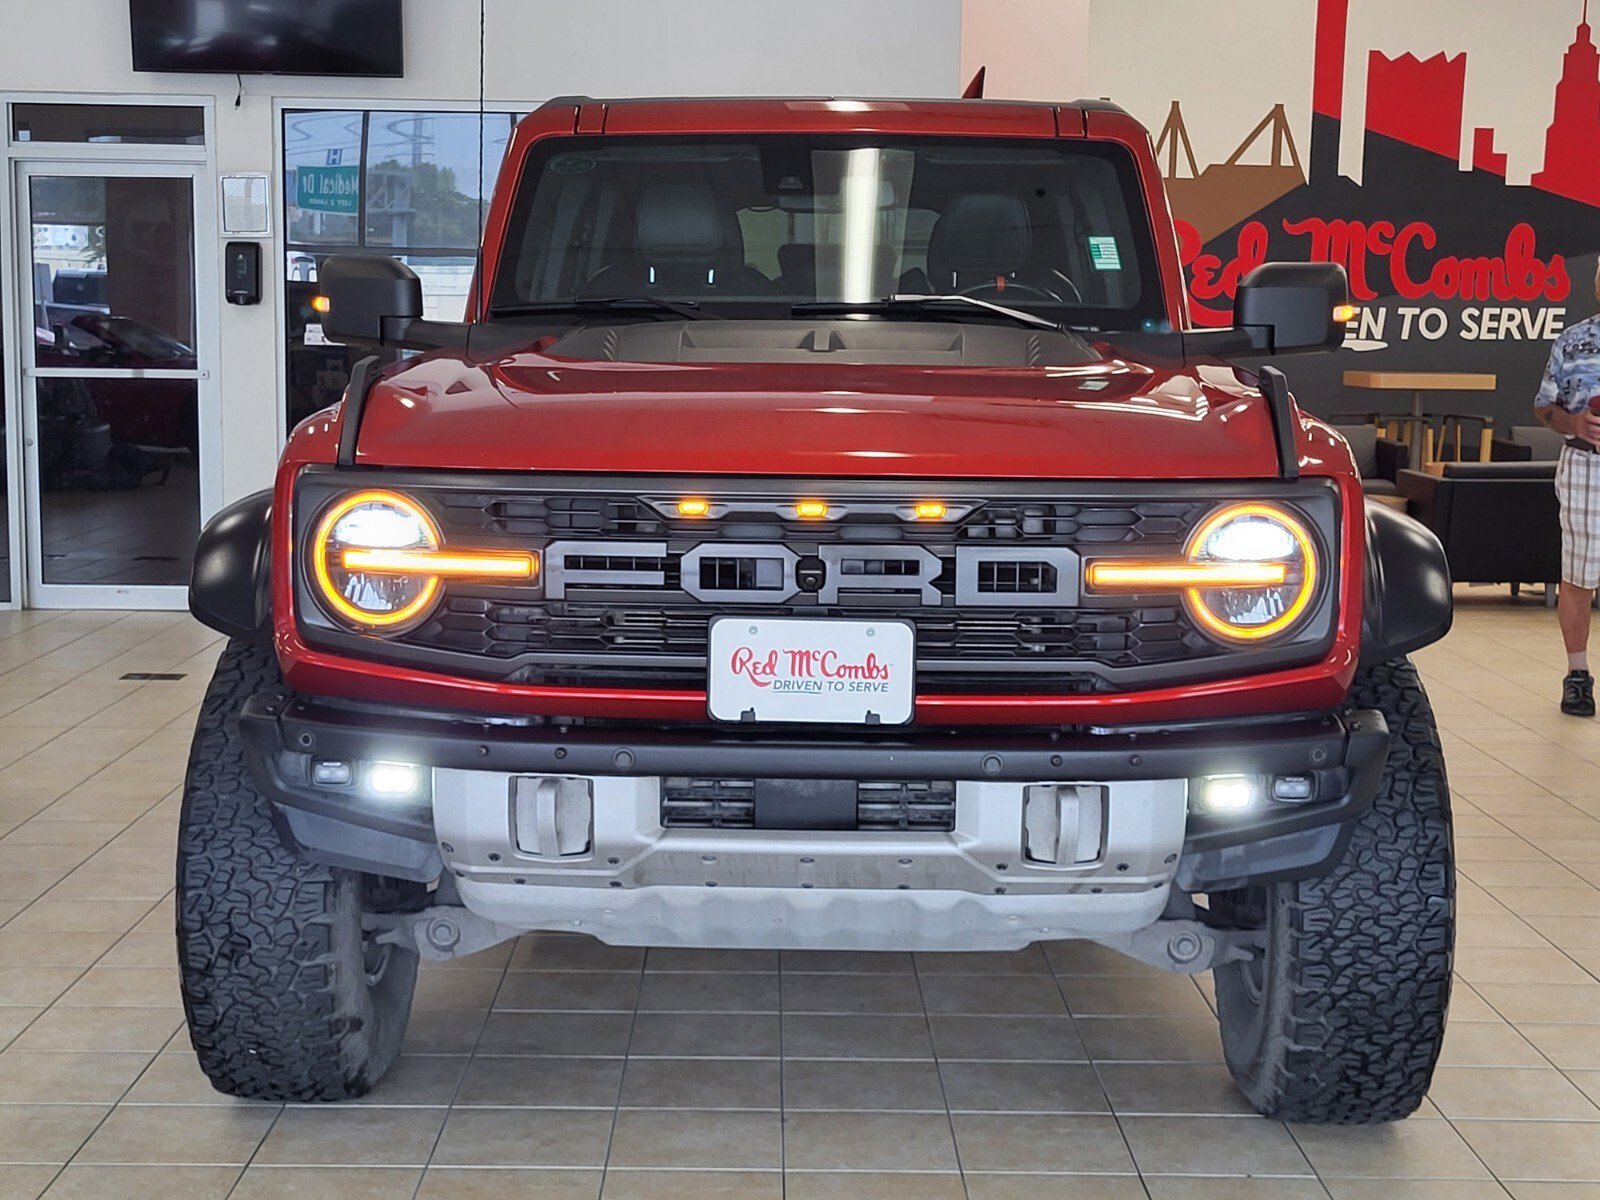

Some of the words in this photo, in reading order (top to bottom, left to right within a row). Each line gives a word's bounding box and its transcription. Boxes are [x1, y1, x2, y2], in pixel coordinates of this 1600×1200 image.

[328, 150, 341, 164] H
[1282, 217, 1572, 301] McCombs
[1397, 307, 1448, 340] TO
[1459, 307, 1566, 340] SERVE
[545, 540, 1079, 607] FORD
[731, 647, 778, 687] Red
[783, 649, 889, 680] McCombs
[773, 680, 822, 691] DRIVEN
[828, 682, 844, 692] TO
[848, 682, 889, 692] SERVE
